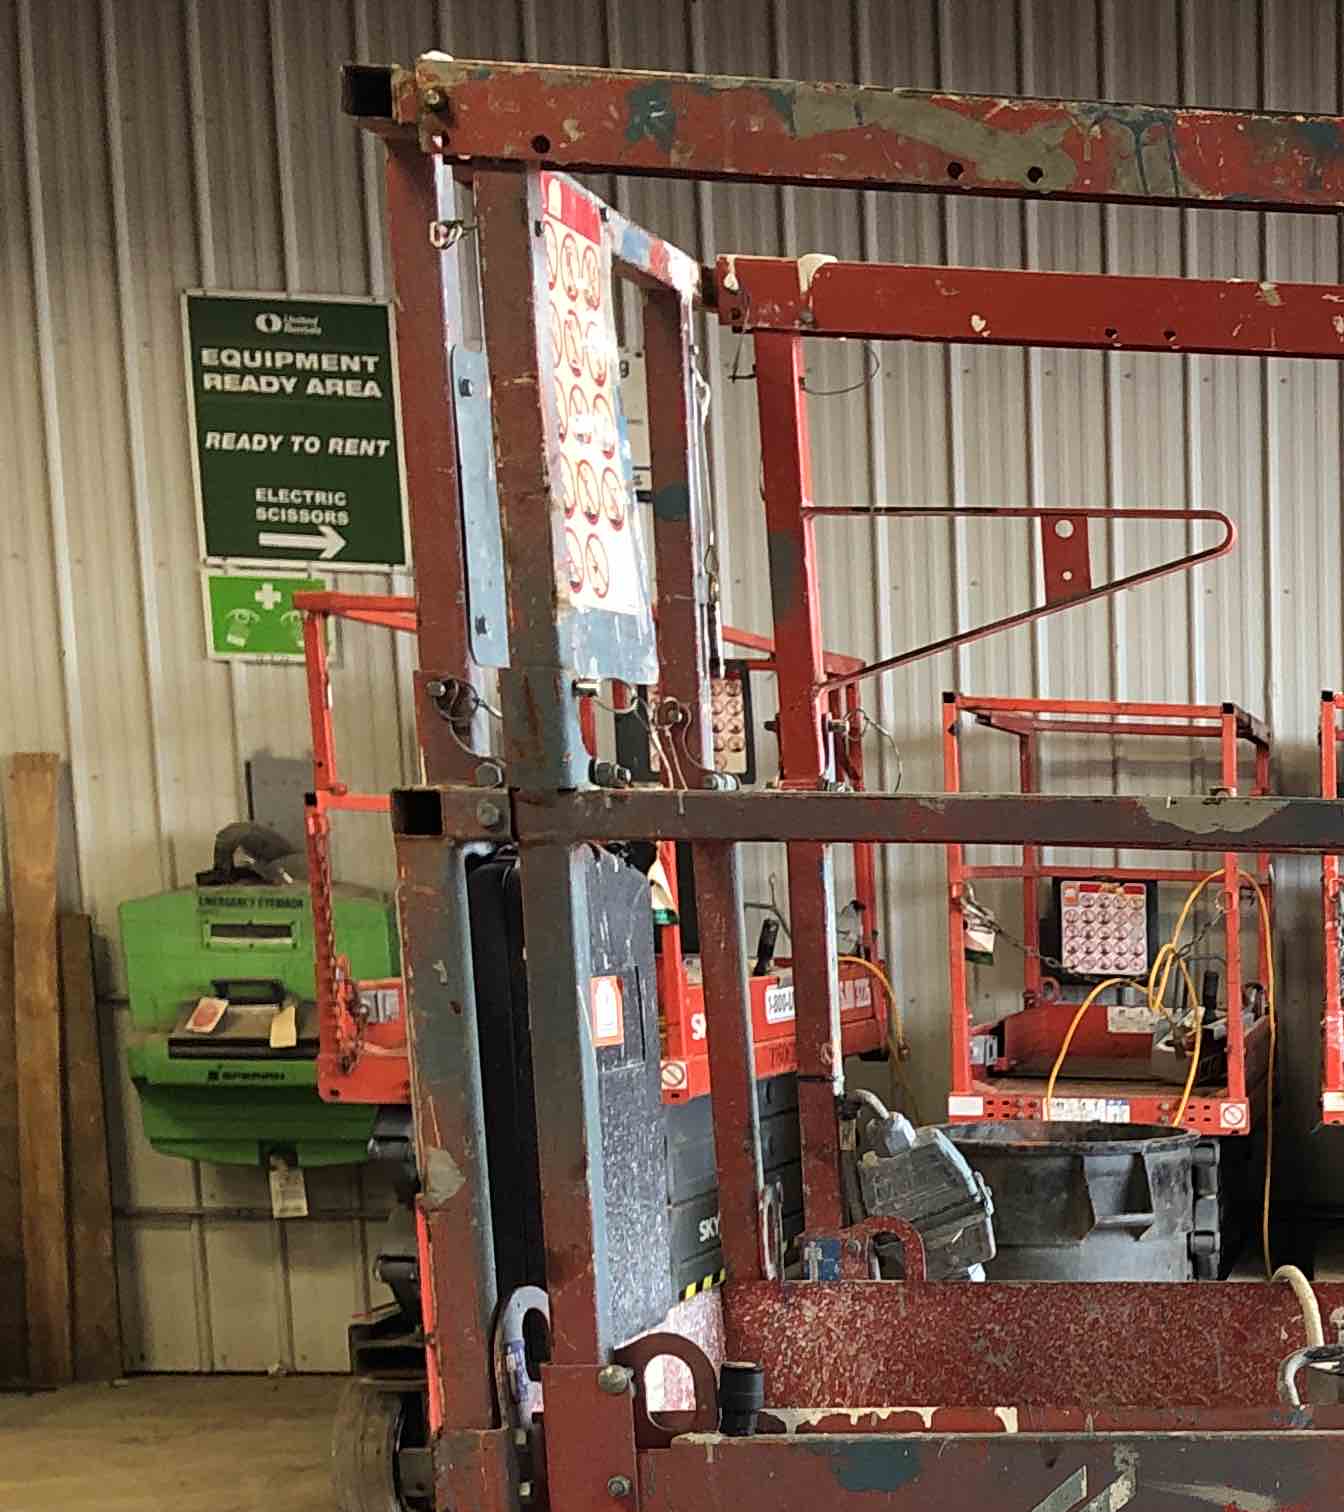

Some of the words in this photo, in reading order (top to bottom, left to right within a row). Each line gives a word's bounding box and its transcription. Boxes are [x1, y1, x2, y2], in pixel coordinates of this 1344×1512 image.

[201, 347, 379, 373] EQUIPMENT
[203, 372, 297, 394] READY
[305, 377, 382, 398] AREA
[205, 431, 284, 452] READY
[291, 435, 320, 453] TO
[328, 437, 390, 457] RENT
[255, 487, 347, 506] ELECTRIC
[255, 507, 349, 526] SCISSORS
